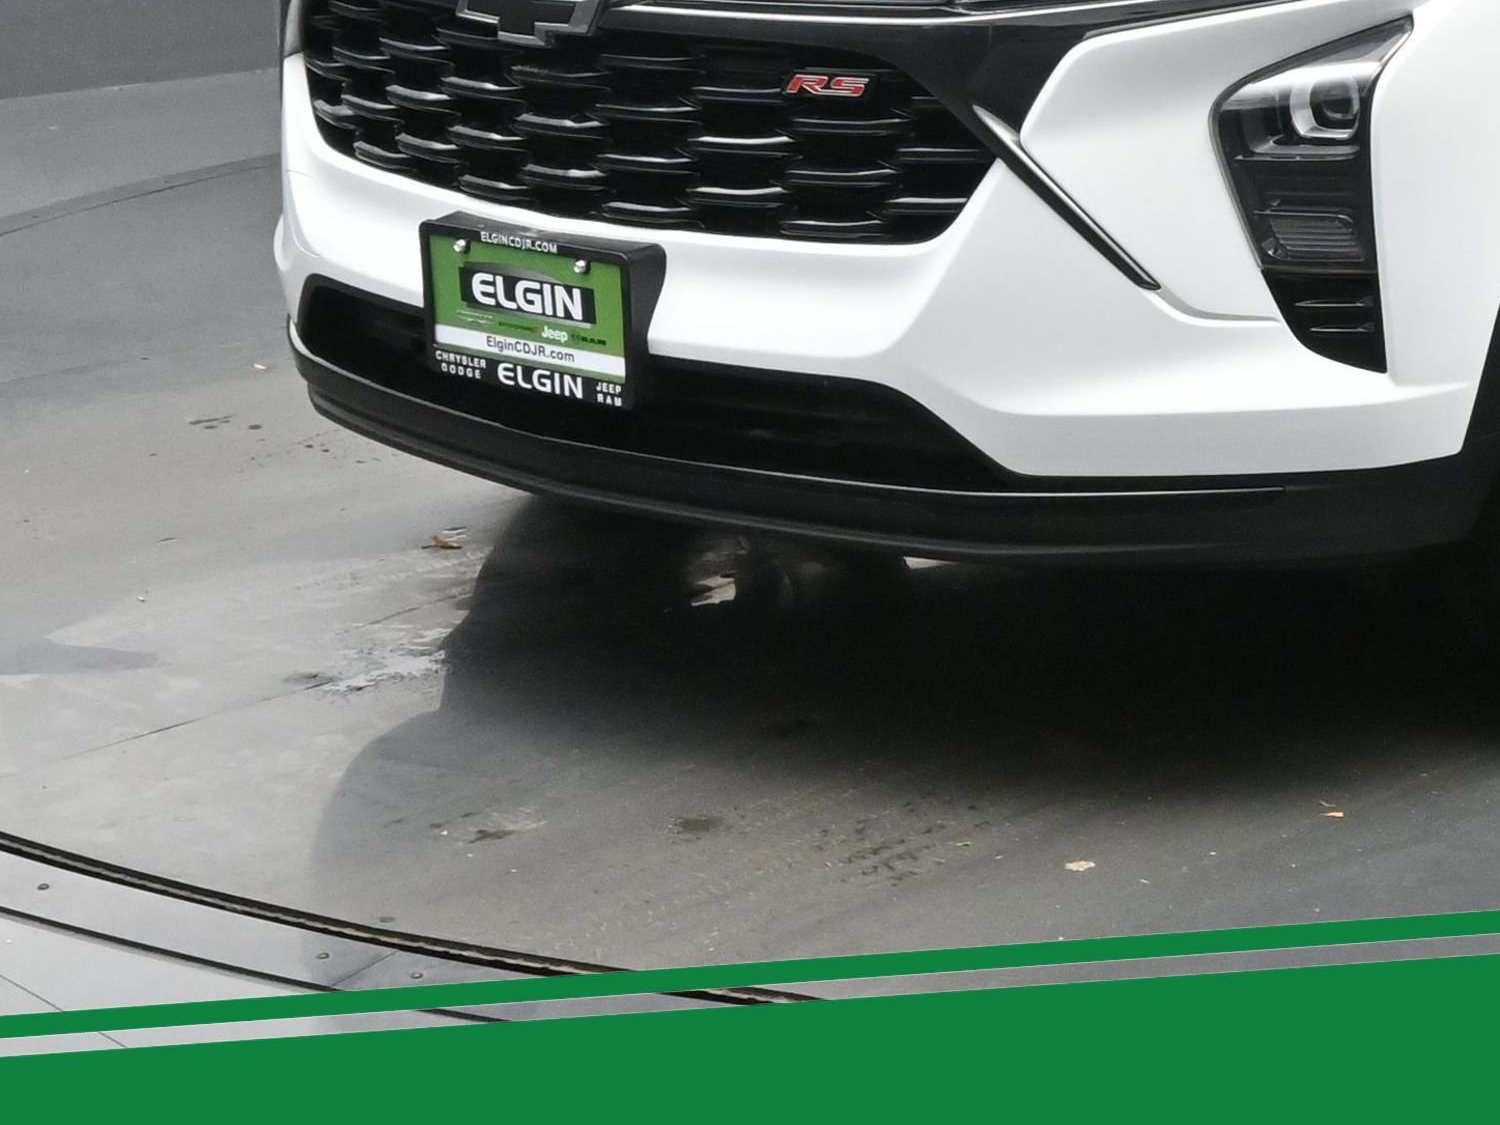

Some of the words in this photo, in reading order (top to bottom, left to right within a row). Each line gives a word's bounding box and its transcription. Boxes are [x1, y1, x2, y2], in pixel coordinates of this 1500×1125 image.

[786, 74, 870, 97] RS
[481, 231, 557, 254] ELGINCDJR.COM
[472, 272, 583, 320] ELGIN
[541, 325, 569, 343] Jeep
[435, 350, 487, 369] CHRYSLER
[486, 336, 575, 362] ElginCDJR.com
[441, 362, 482, 380] DODGE
[497, 363, 584, 399] ELGIN
[596, 381, 622, 395] JEEP
[597, 393, 622, 408] RAM
